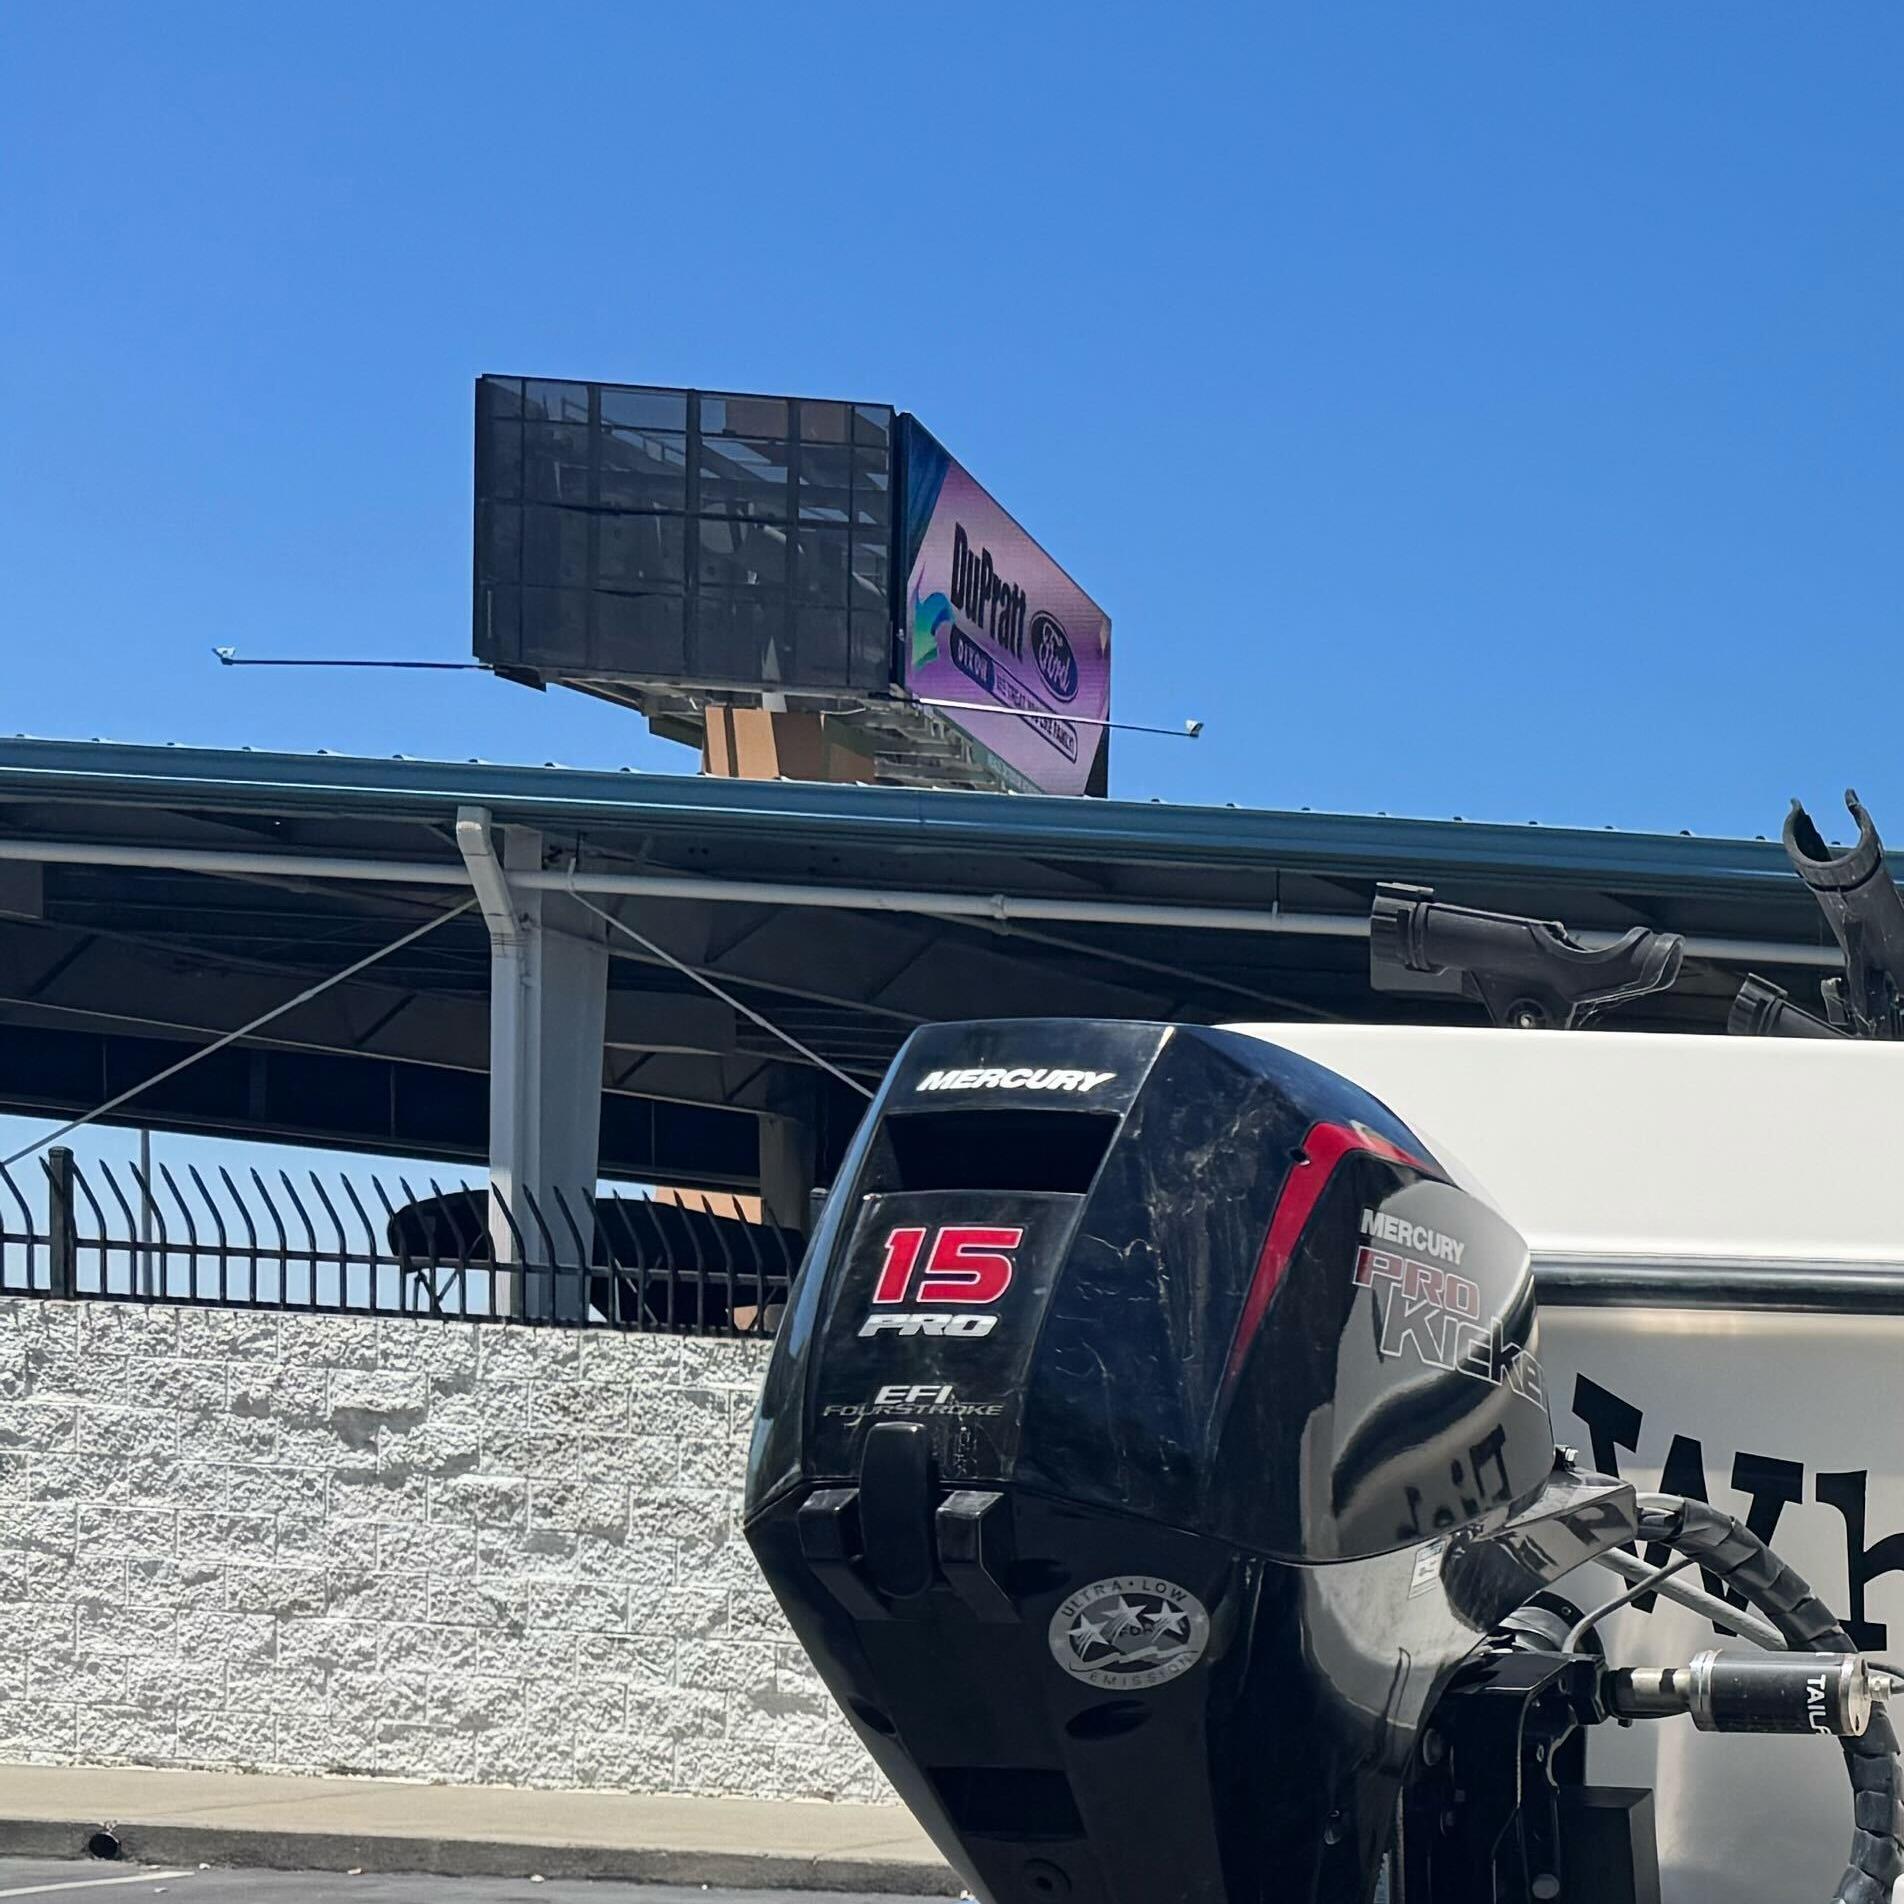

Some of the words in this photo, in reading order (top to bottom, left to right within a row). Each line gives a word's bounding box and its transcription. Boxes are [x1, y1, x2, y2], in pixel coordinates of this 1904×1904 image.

[950, 521, 1026, 662] DuPratt
[1039, 622, 1071, 692] Ford
[916, 1067, 1118, 1092] MERCURY
[1360, 1208, 1465, 1265] MERCURY
[872, 1227, 1025, 1304] 15
[1352, 1245, 1481, 1321] PRO
[857, 1313, 1000, 1338] PRO
[823, 1403, 1004, 1418] FOURSTROKE
[874, 1384, 954, 1405] EFI
[1061, 1579, 1123, 1618] ULTRA
[1141, 1578, 1188, 1602] LOW
[1089, 1653, 1193, 1686] EMISSION
